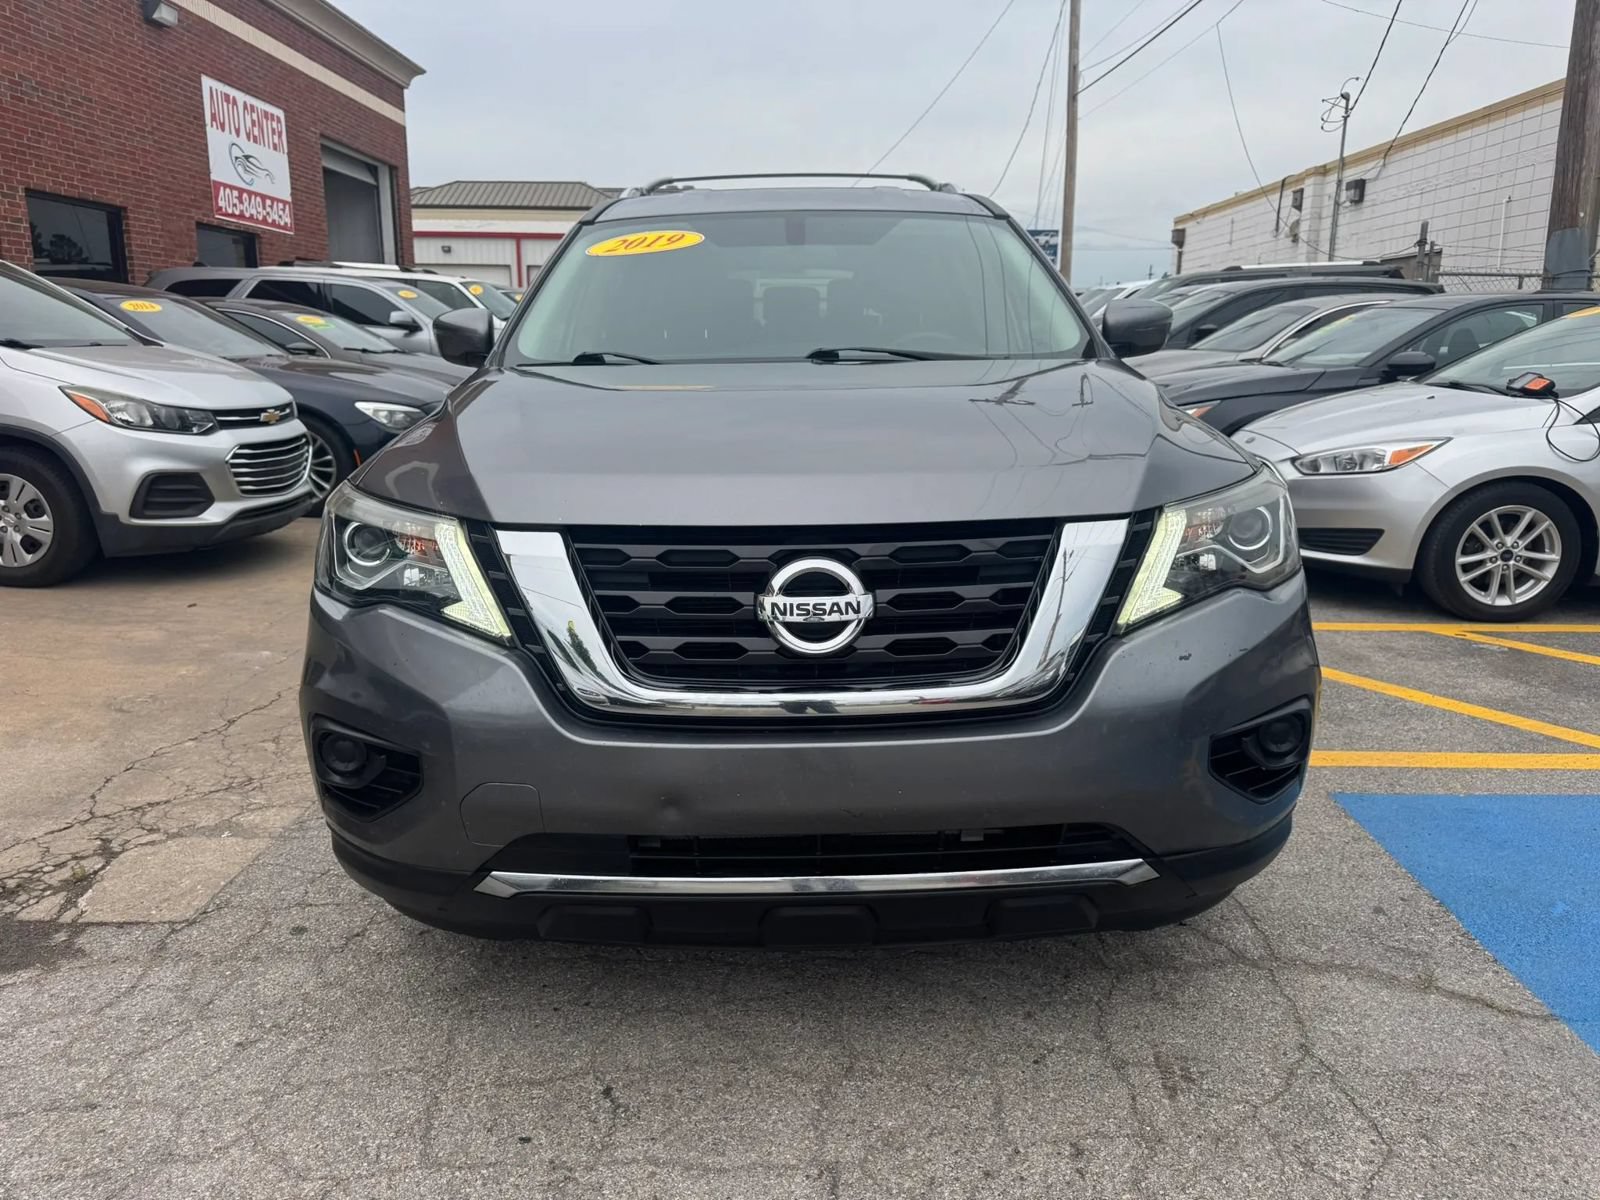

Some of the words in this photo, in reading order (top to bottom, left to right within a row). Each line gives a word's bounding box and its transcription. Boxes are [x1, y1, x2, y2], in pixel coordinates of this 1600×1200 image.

[209, 86, 240, 138] AUTO
[243, 101, 285, 155] CENTER
[217, 186, 291, 227] 405-849-5454
[604, 233, 685, 253] 2019
[770, 601, 861, 617] NISSAN
